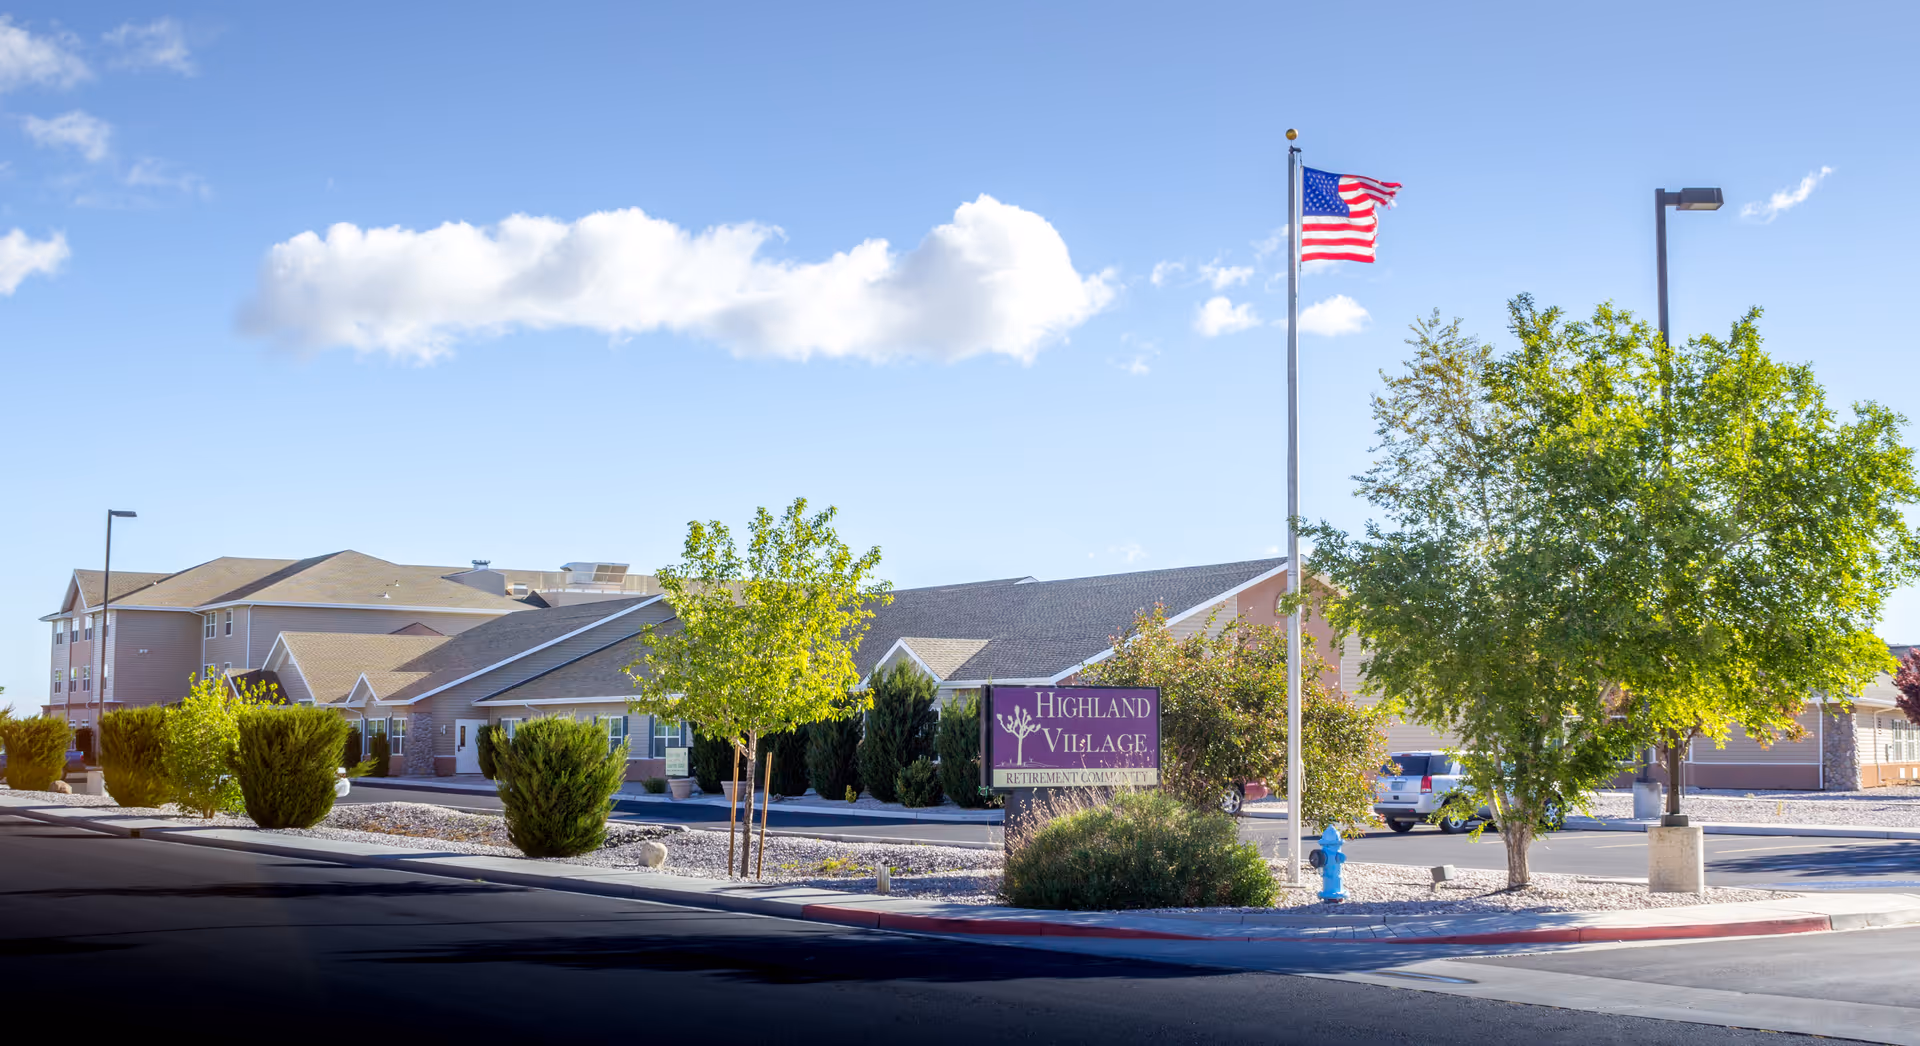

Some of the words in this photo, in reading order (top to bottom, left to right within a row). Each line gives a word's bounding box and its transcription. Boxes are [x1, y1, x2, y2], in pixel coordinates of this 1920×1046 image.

[1035, 691, 1151, 718] HIGHLAND
[1041, 727, 1148, 753] VILLAGE
[1006, 771, 1079, 785] RETIREMENT
